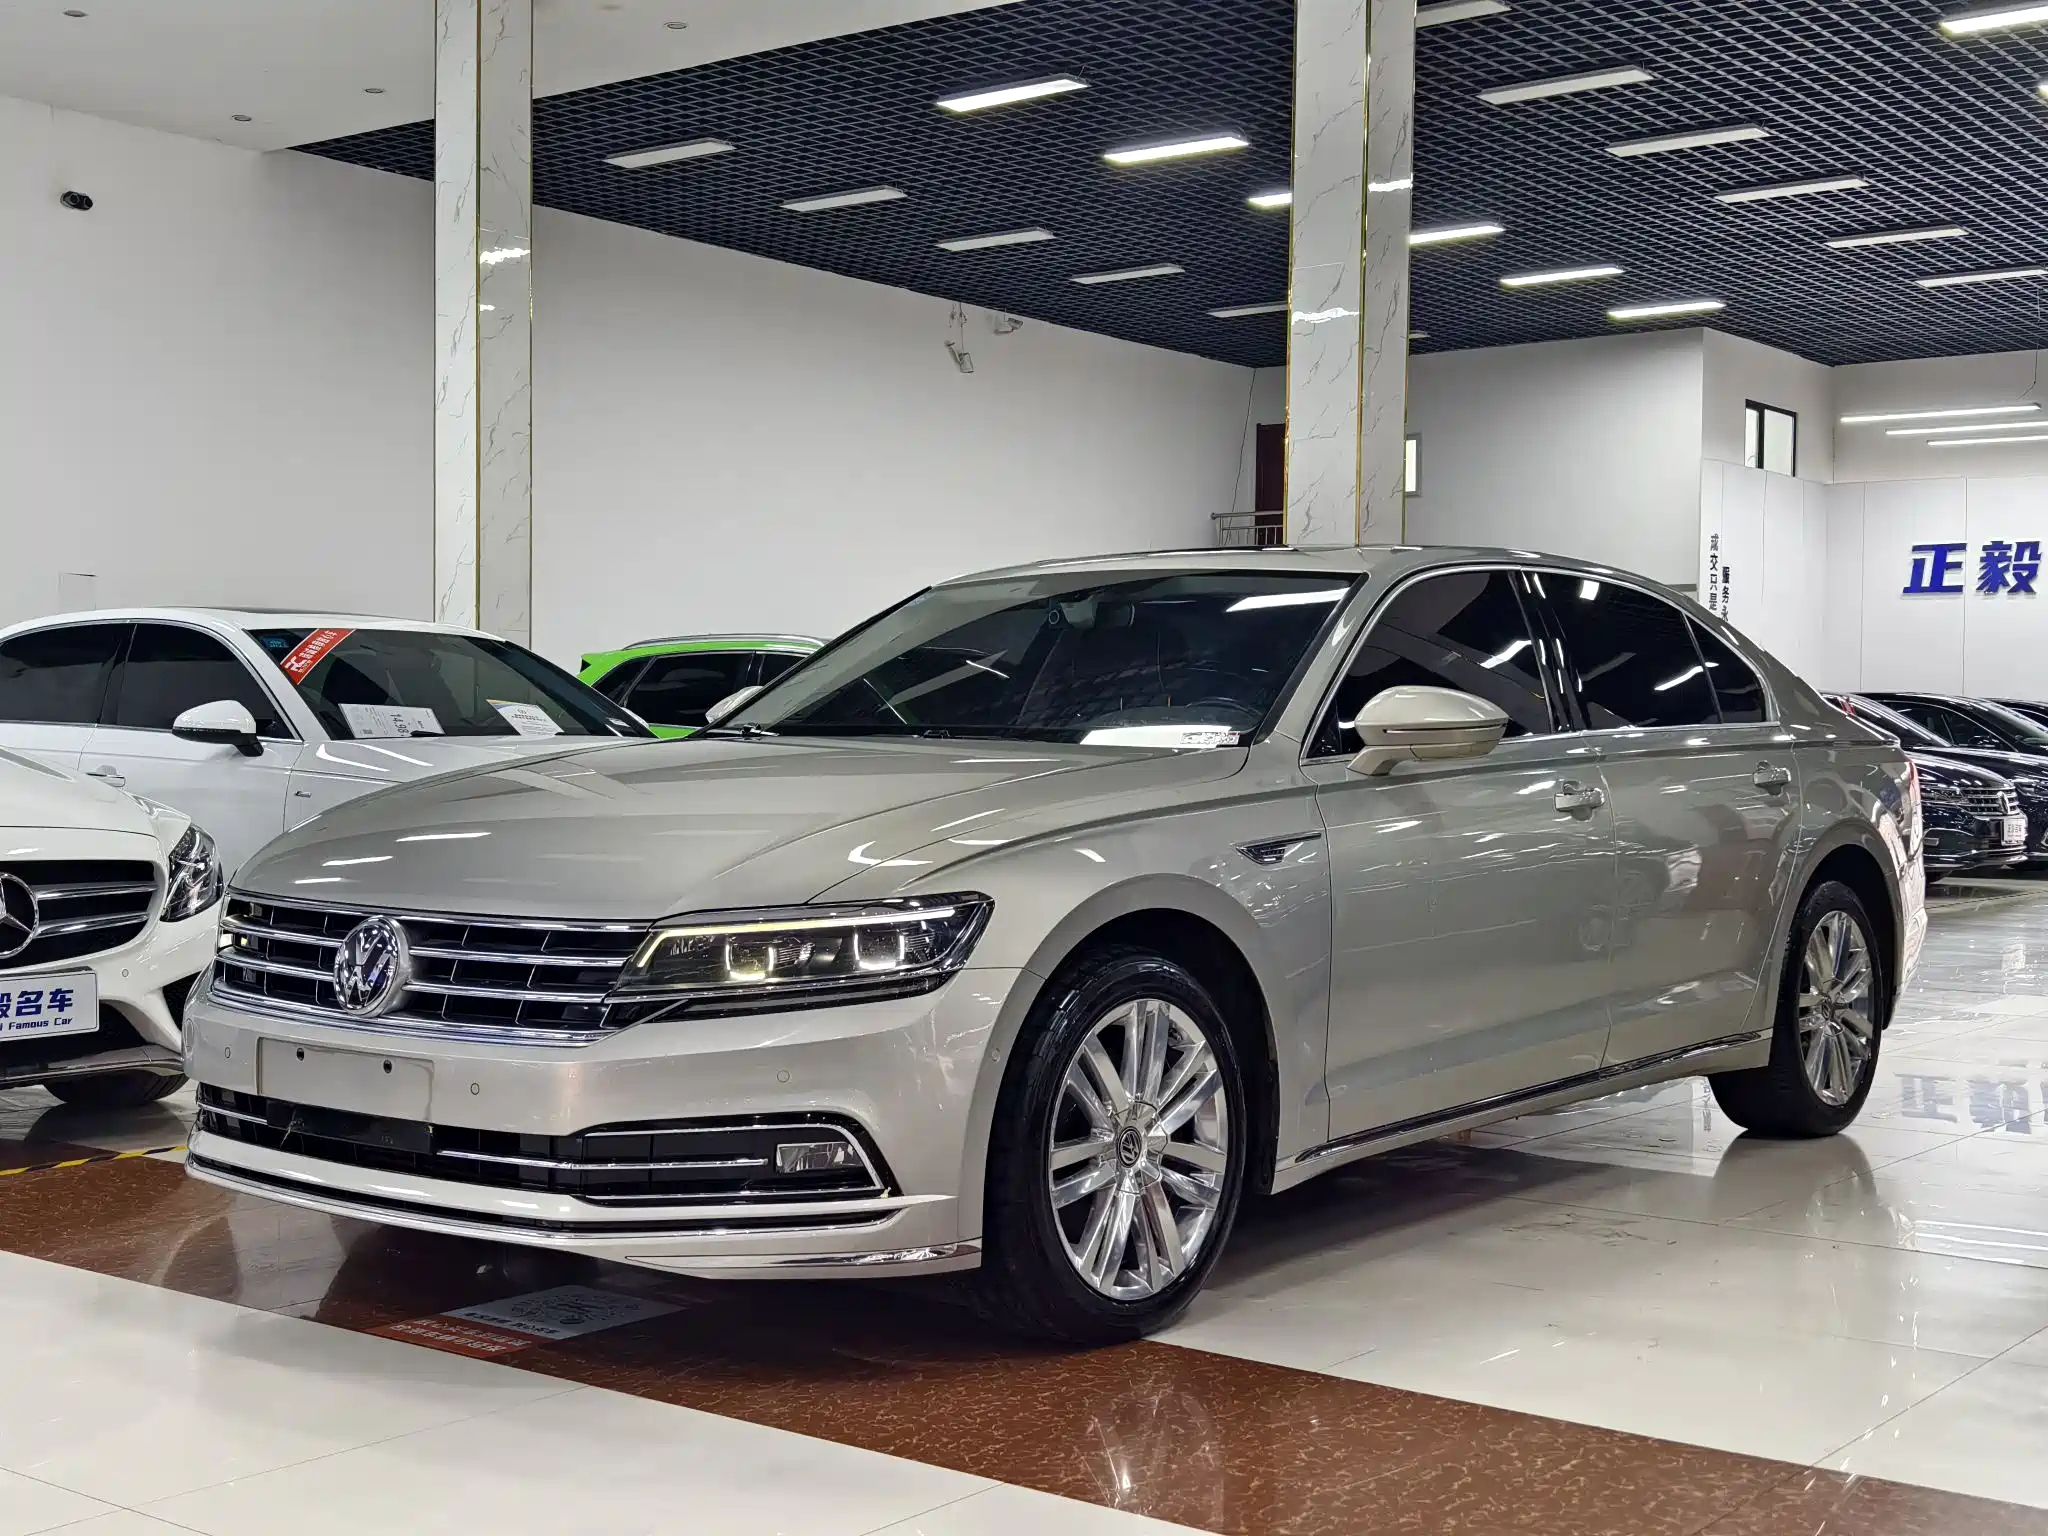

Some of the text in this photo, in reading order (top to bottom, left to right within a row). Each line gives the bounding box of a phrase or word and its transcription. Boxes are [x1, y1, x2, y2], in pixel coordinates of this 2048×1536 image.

[1902, 540, 2042, 595] 正毅
[8, 1020, 49, 1031] Famous
[54, 1017, 73, 1026] Car
